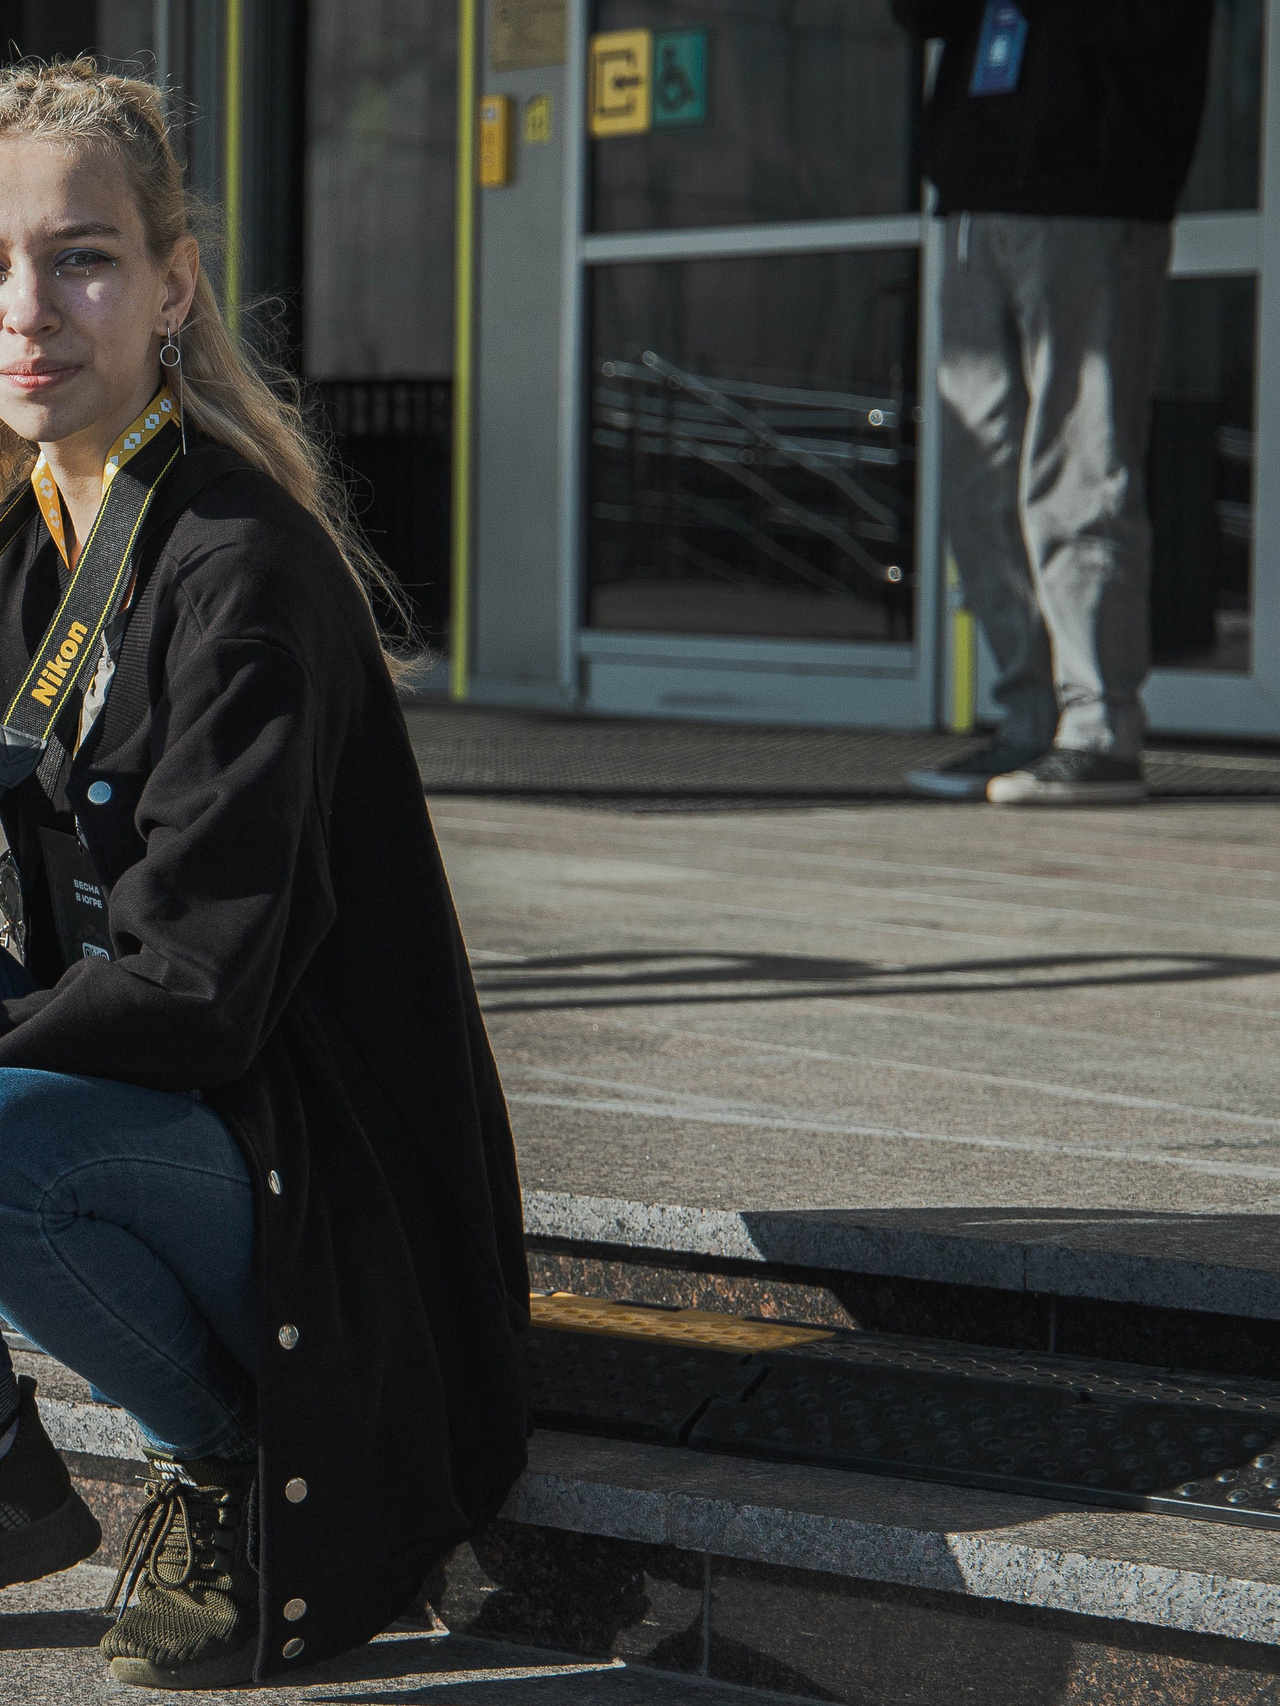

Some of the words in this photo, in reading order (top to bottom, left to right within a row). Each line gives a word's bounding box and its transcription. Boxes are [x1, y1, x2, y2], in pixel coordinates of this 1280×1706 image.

[31, 621, 89, 707] Nikon
[73, 879, 100, 895] ВЕСНА
[75, 893, 81, 902] В
[82, 895, 102, 908] ЮГРЕ
